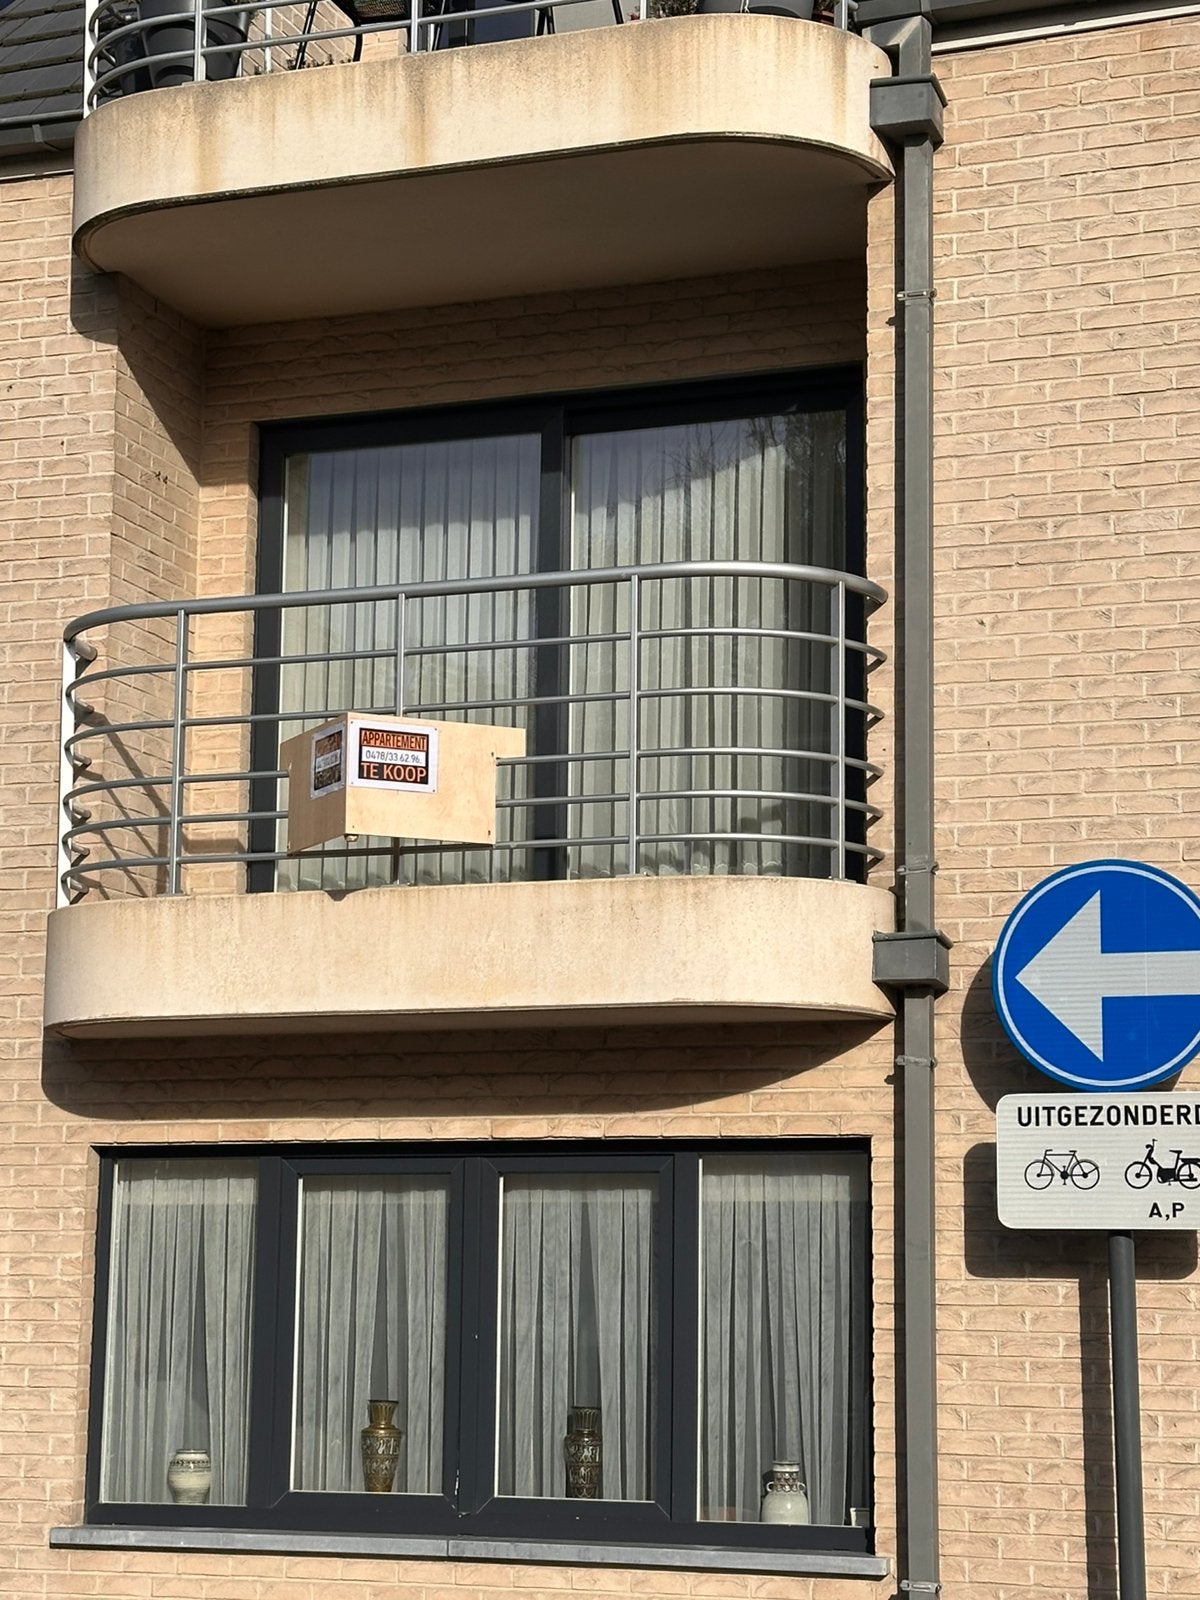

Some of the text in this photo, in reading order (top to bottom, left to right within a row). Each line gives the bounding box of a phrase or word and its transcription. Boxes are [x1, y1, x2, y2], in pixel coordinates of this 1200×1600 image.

[362, 731, 426, 750] APPARTEMENT
[361, 763, 379, 779] TE
[383, 764, 427, 782] KOOP
